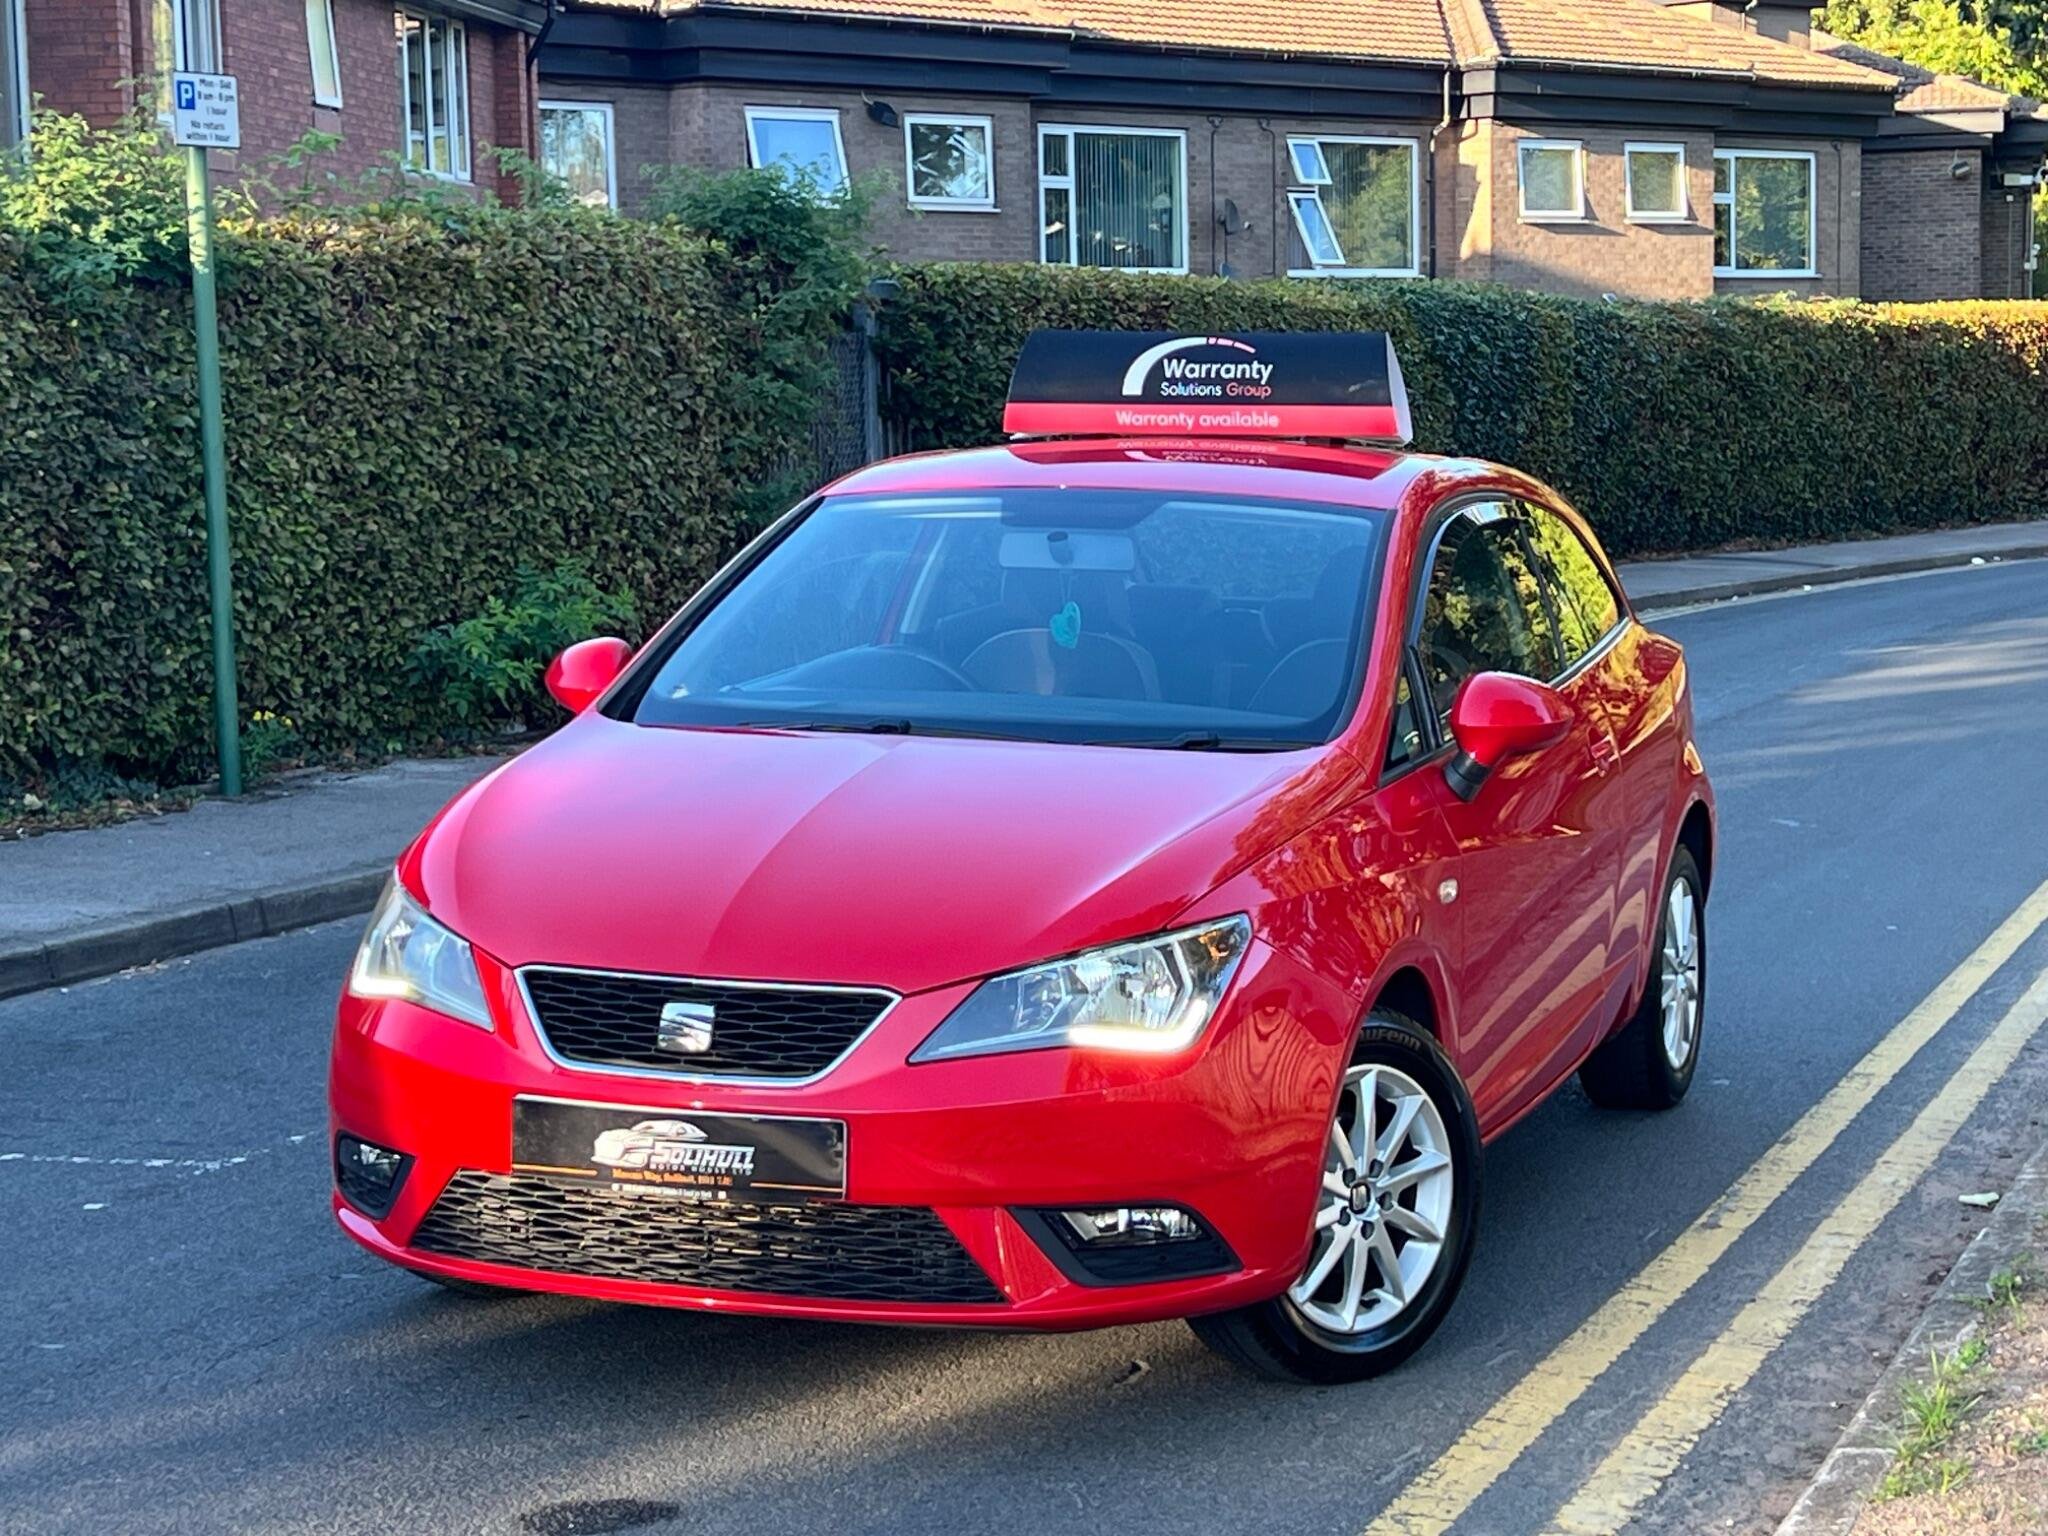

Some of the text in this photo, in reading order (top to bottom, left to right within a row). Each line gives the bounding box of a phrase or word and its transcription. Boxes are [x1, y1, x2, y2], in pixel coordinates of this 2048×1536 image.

[180, 83, 193, 108] P
[191, 120, 201, 129] No
[1163, 357, 1274, 384] Warranty
[1160, 382, 1272, 399] Solutions Group
[1116, 411, 1279, 430] Warranty available
[649, 1142, 755, 1169] SOLIHULL
